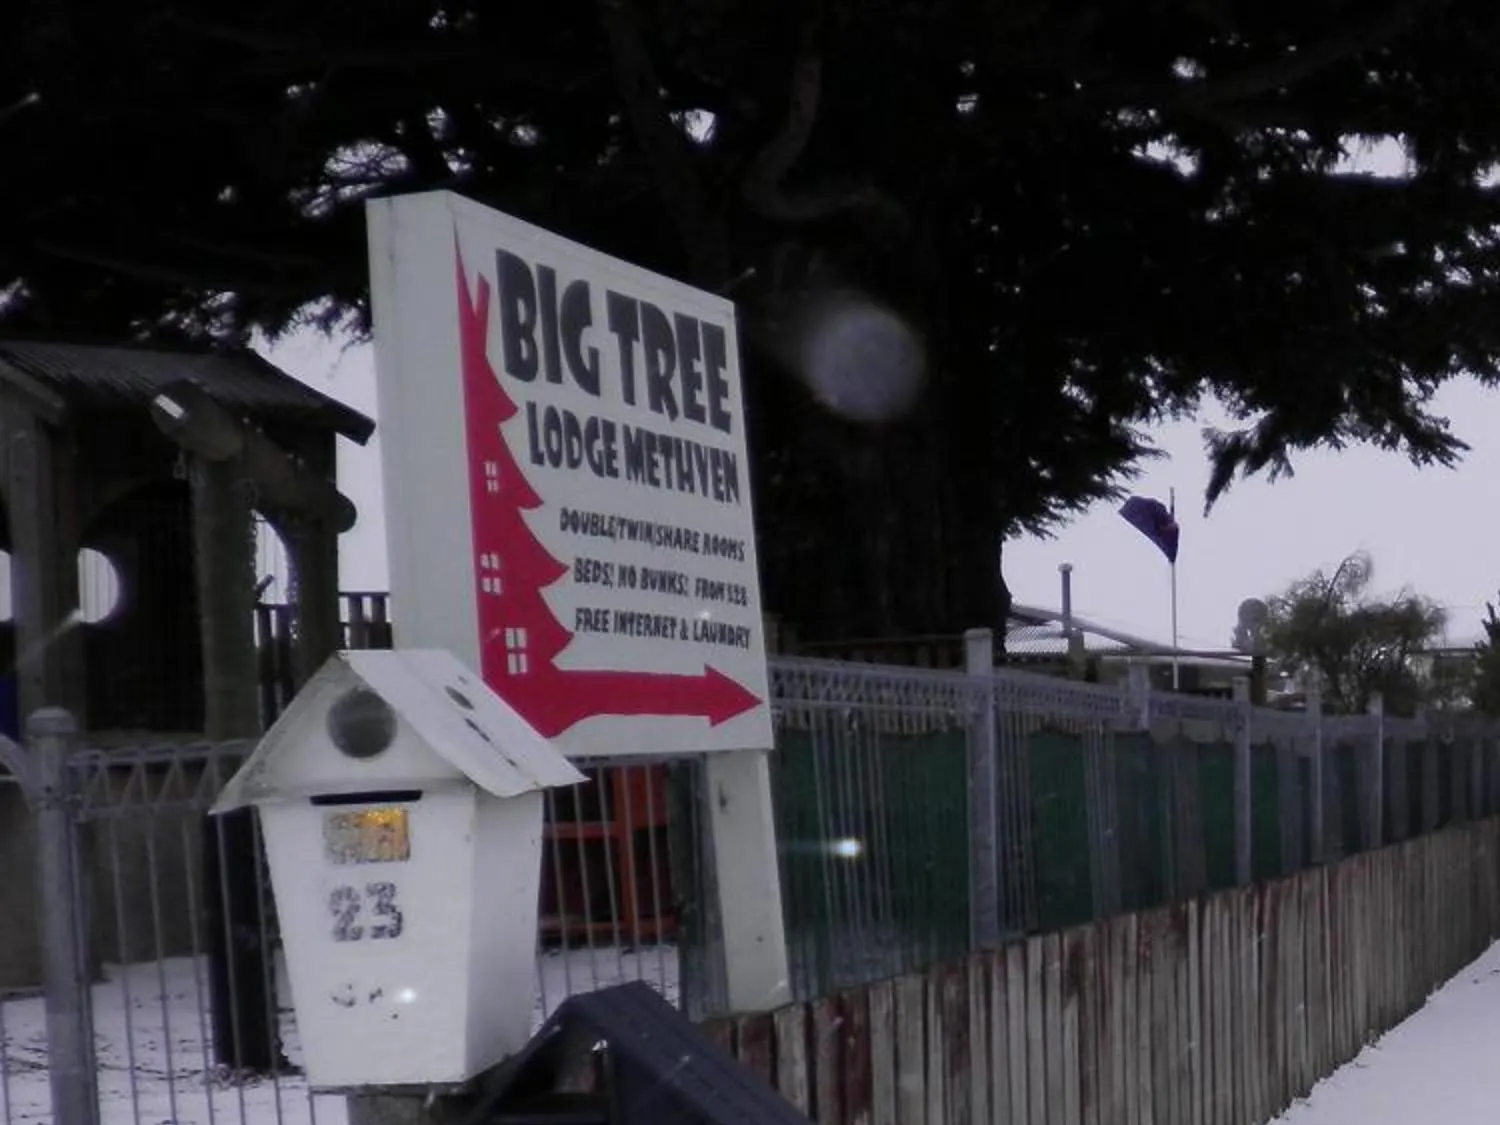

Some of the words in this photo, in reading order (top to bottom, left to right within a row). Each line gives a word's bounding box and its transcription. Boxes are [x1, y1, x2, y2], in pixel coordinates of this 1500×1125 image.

[496, 248, 602, 398] BIG
[606, 288, 732, 435] TREE
[525, 400, 619, 479] LODGE
[623, 422, 742, 506] METHVEN
[702, 533, 746, 562] ROOMS
[617, 564, 637, 590] NO
[695, 577, 725, 603] FROM
[575, 607, 610, 633] FREE
[613, 609, 677, 640] INTERNET
[680, 617, 689, 641] &
[692, 619, 750, 650] LAUNDRY
[328, 881, 404, 942] 23
